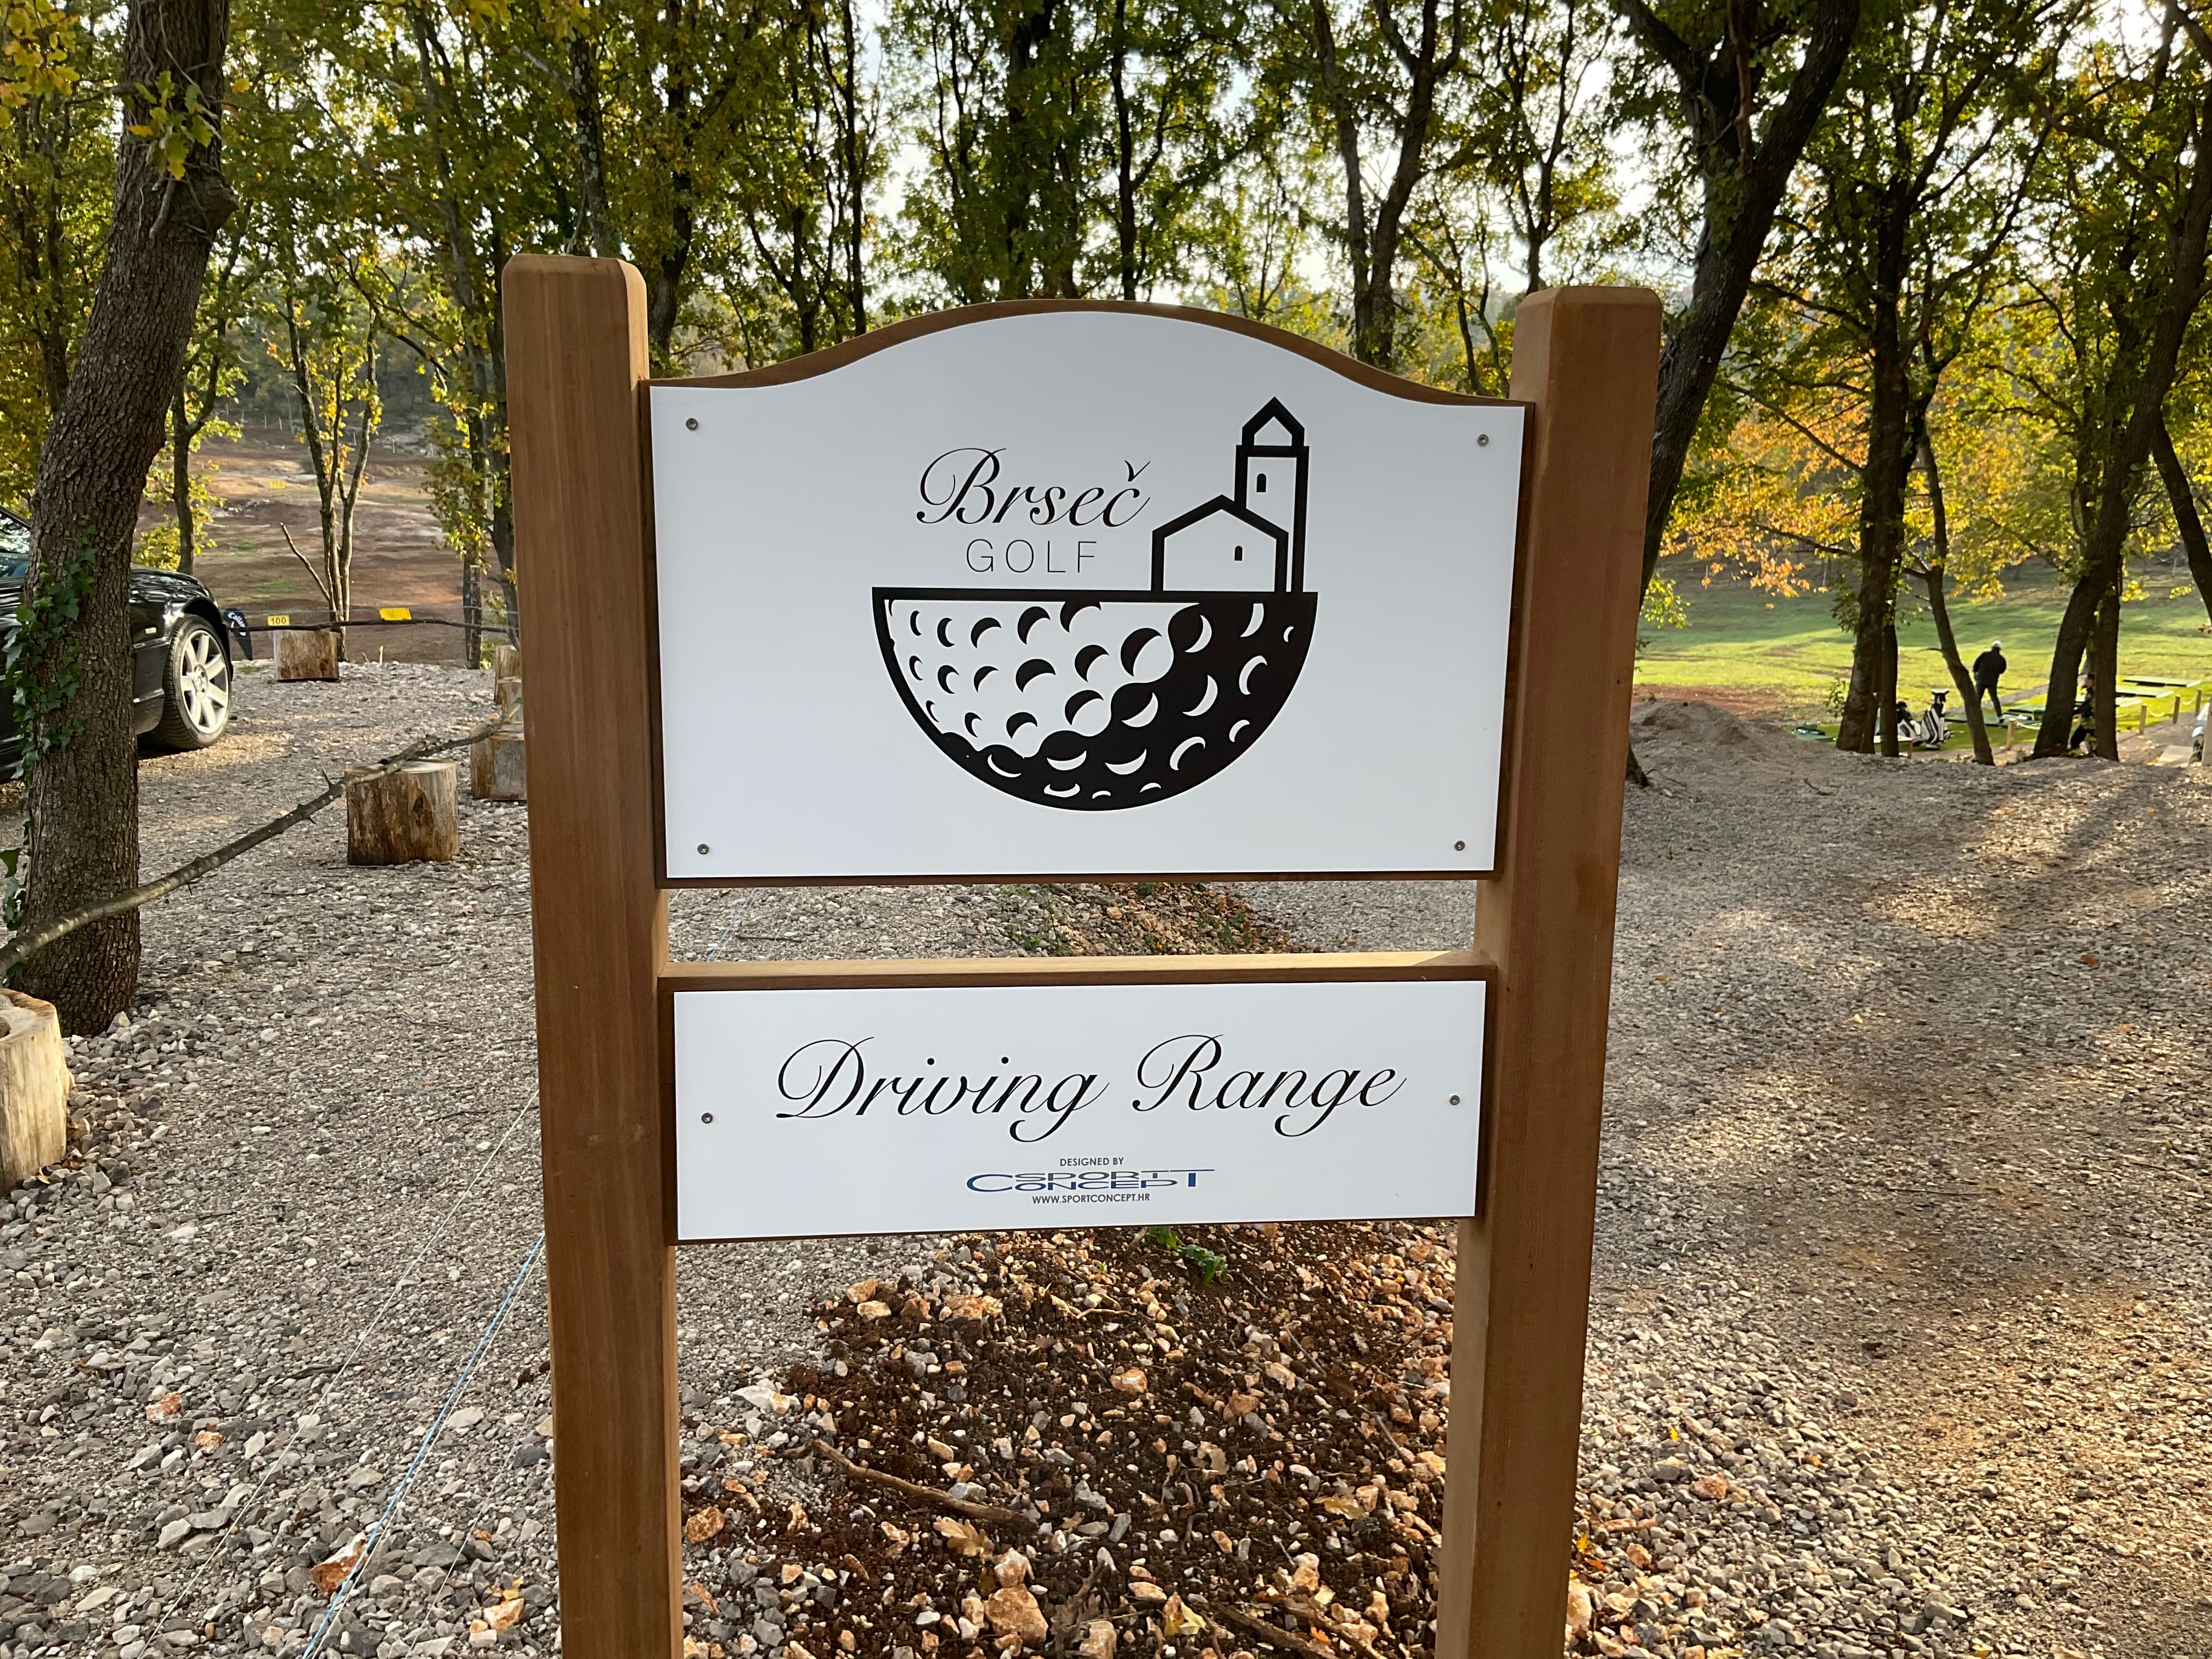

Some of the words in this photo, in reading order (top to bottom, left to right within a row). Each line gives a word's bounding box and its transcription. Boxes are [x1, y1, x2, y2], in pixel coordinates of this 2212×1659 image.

[916, 448, 1151, 528] Brseč
[966, 539, 1097, 573] GOLF
[776, 1036, 1110, 1143] Driving
[1132, 1034, 1407, 1137] Range
[1060, 1158, 1109, 1166] DESIGNED
[1113, 1157, 1124, 1165] BY
[966, 1169, 1215, 1192] CONCEPT
[1014, 1170, 1170, 1182] SPORT
[1032, 1193, 1150, 1204] WWW.SPORTCONCEPT.HR
